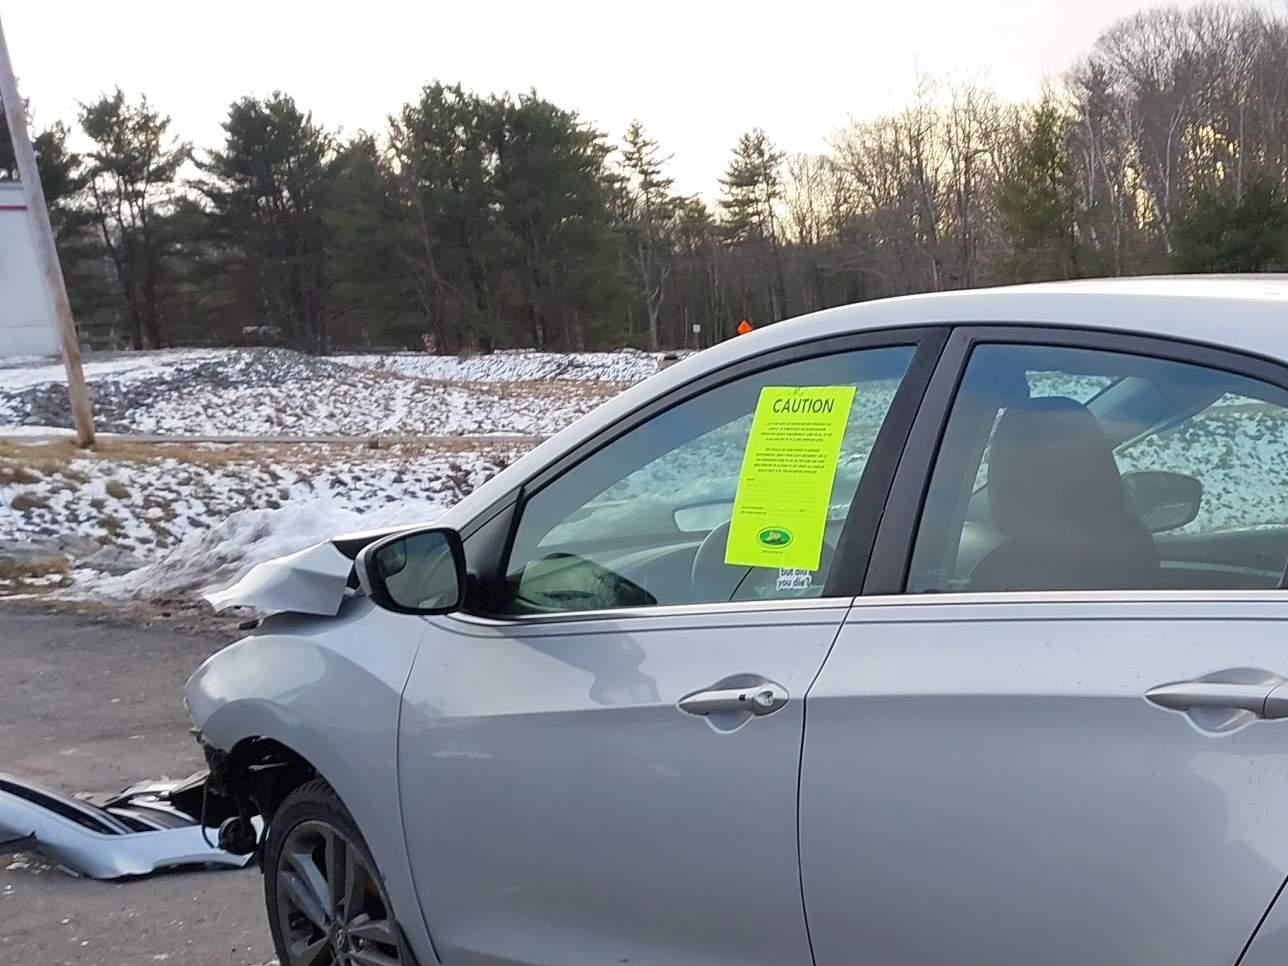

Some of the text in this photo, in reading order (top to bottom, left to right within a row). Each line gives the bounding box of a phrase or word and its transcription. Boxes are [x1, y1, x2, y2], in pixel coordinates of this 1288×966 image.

[772, 398, 835, 414] CAUTION
[777, 577, 810, 590] you die?
